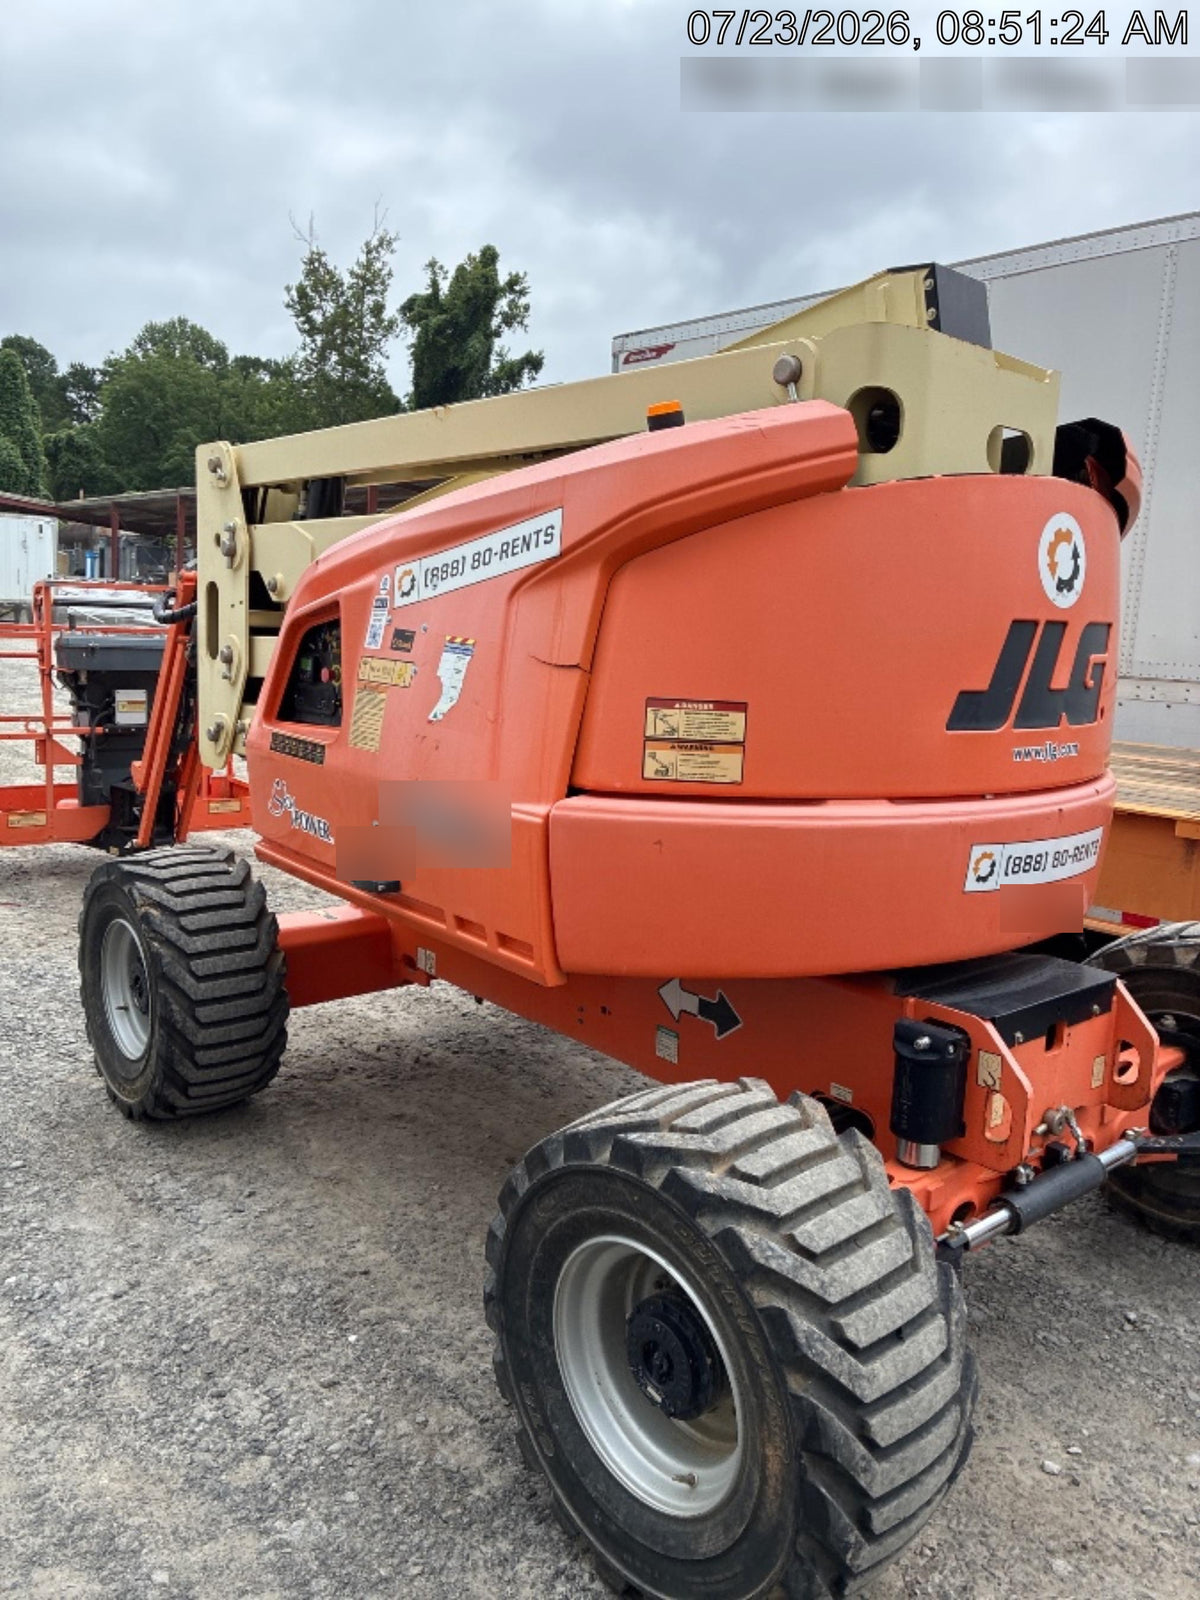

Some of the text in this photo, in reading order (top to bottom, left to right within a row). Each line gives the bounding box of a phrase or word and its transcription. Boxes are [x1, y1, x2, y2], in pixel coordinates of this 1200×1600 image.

[424, 524, 555, 588] (888) 80-RENTS
[946, 619, 1112, 731] JLG
[1013, 742, 1079, 762] www.jlg.com
[1004, 838, 1101, 877] (888) 80-RENTS
